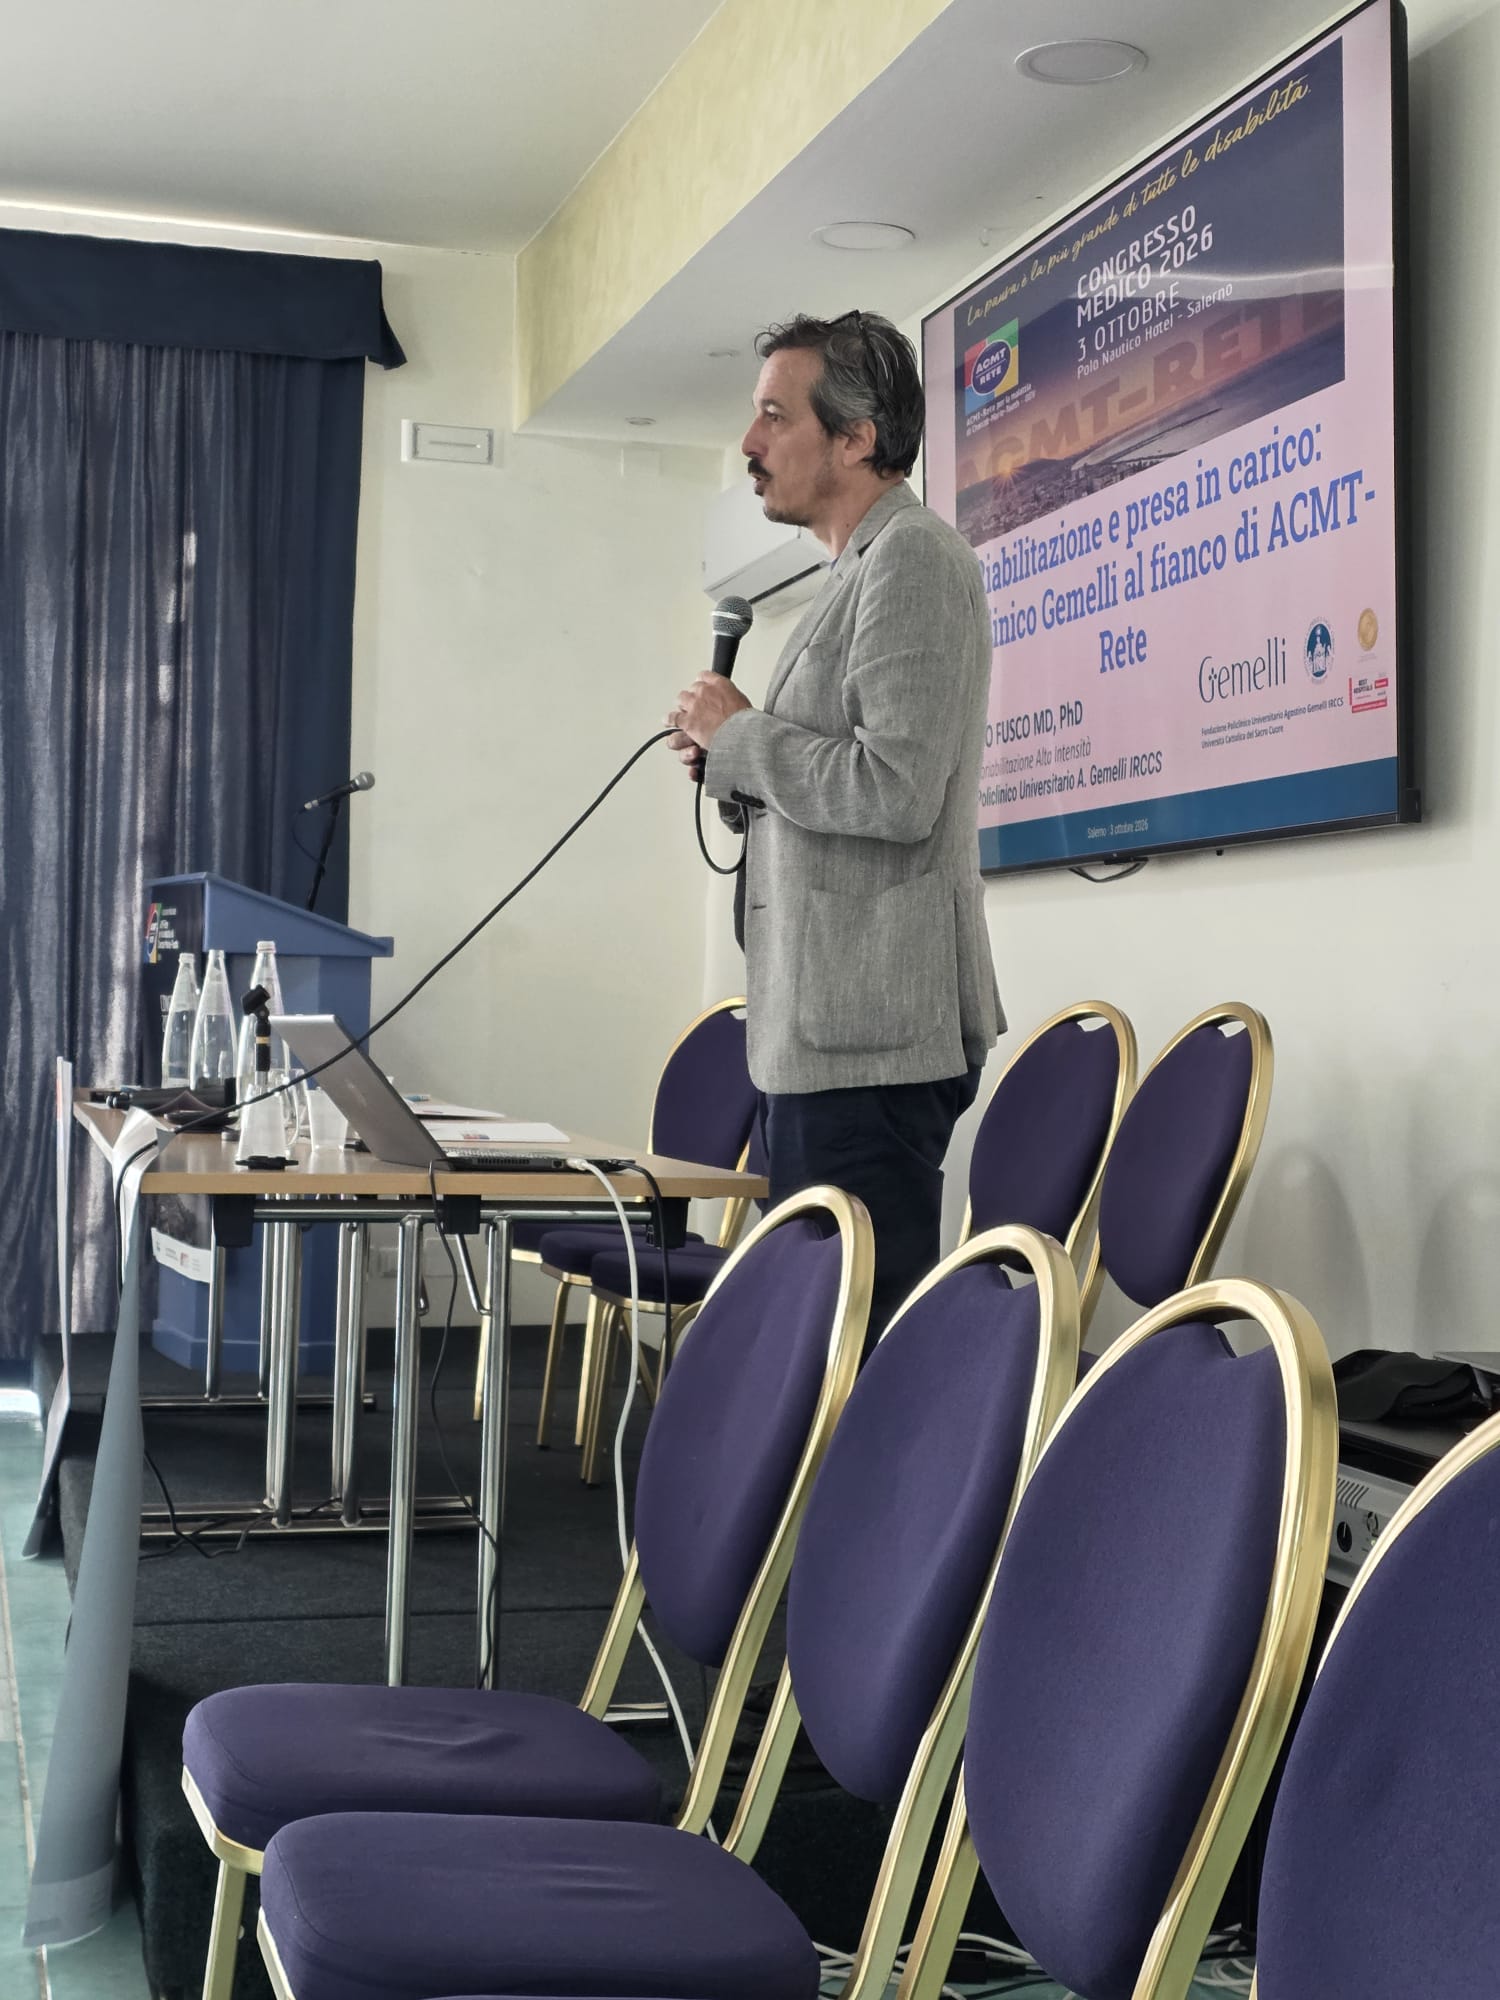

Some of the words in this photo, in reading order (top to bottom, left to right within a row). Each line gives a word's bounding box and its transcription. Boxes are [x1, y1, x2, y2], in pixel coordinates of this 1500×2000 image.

[967, 305, 984, 326] La
[1030, 260, 1046, 281] la
[1071, 206, 1120, 262] grande
[1123, 192, 1138, 218] di
[1140, 166, 1178, 206] tutte
[1181, 149, 1200, 178] le
[1077, 205, 1196, 299] CONGRESSO
[1077, 263, 1151, 328] MEDICO
[1159, 223, 1213, 278] 2026
[975, 347, 1006, 375] ACMT
[1077, 337, 1086, 362] 3
[1094, 282, 1180, 351] OTTOBRE
[1077, 359, 1099, 380] Polo
[1102, 335, 1141, 366] Nautico
[1145, 314, 1174, 342] Hotel
[1187, 283, 1233, 319] Salerno
[980, 365, 1002, 386] RETE
[1109, 511, 1120, 543] e
[1126, 481, 1190, 549] presa
[1196, 459, 1221, 509] in
[1228, 423, 1321, 495] carico:
[991, 600, 1037, 648] inico
[1042, 560, 1119, 630] Gemelli
[1124, 551, 1145, 602] al
[1151, 534, 1227, 593] fianco
[1234, 506, 1260, 563] di
[1267, 470, 1376, 552] ACMT-
[1099, 626, 1147, 674] Rete
[1198, 636, 1286, 703] Gemelli
[996, 714, 1031, 745] FUSCO
[1033, 708, 1057, 736] MD,
[1059, 700, 1084, 730] PhD
[1019, 769, 1075, 801] Universitario
[1077, 767, 1087, 791] A.
[1090, 757, 1127, 787] Gemelli
[1129, 750, 1163, 779] IRCCS
